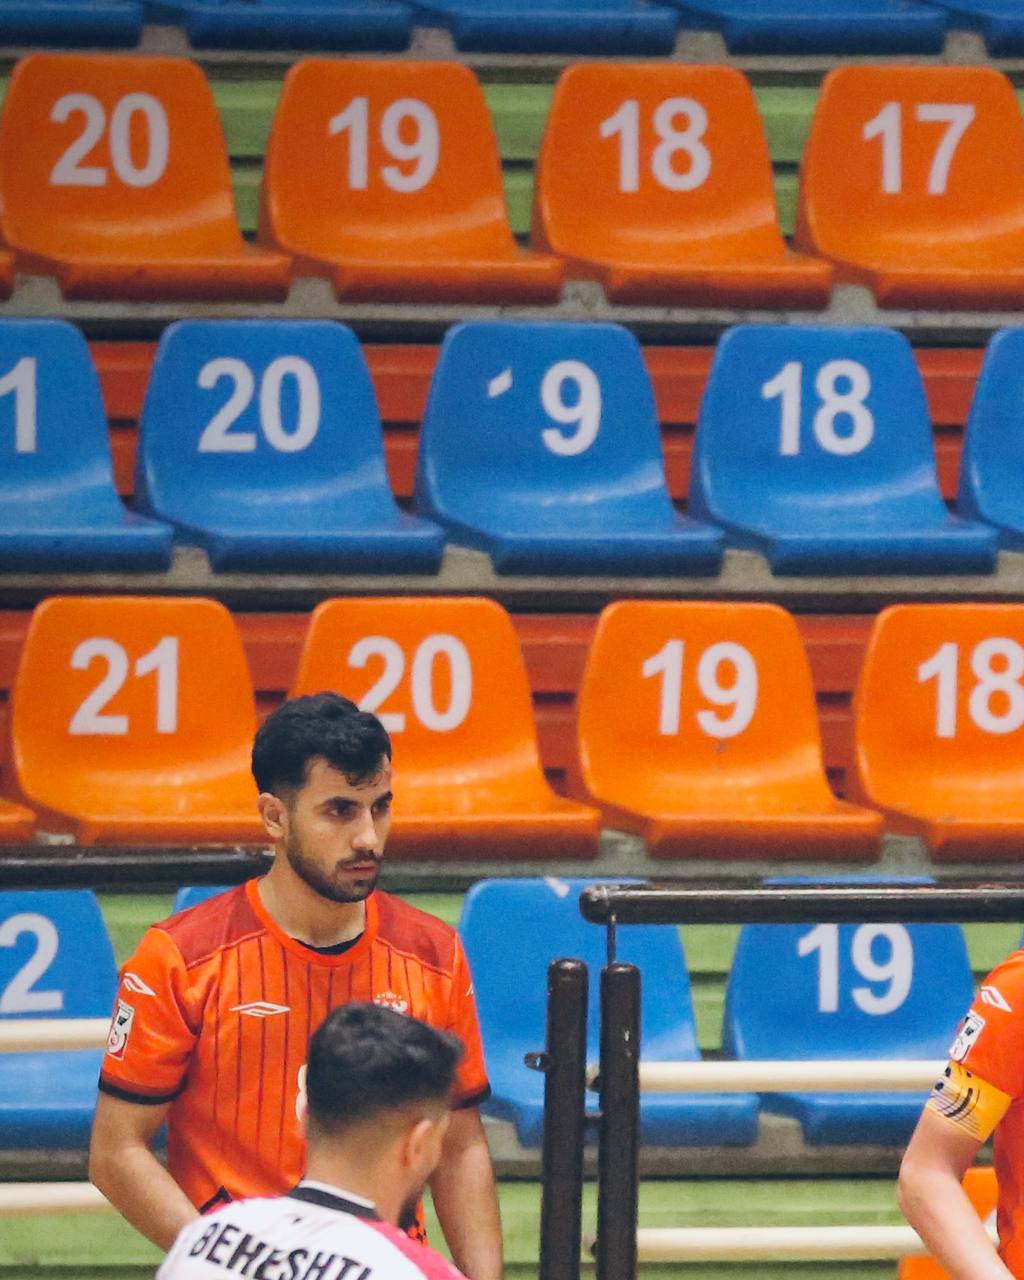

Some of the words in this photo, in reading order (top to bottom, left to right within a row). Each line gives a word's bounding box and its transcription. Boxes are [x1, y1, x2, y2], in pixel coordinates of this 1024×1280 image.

[50, 93, 169, 187] 20
[329, 97, 440, 193] 19
[600, 98, 711, 192] 18
[863, 102, 976, 195] 17
[197, 355, 321, 453] 20
[761, 359, 875, 456] 18
[68, 637, 179, 735] 21
[347, 634, 472, 735] 20
[642, 640, 759, 738] 19
[797, 922, 914, 1016] 19
